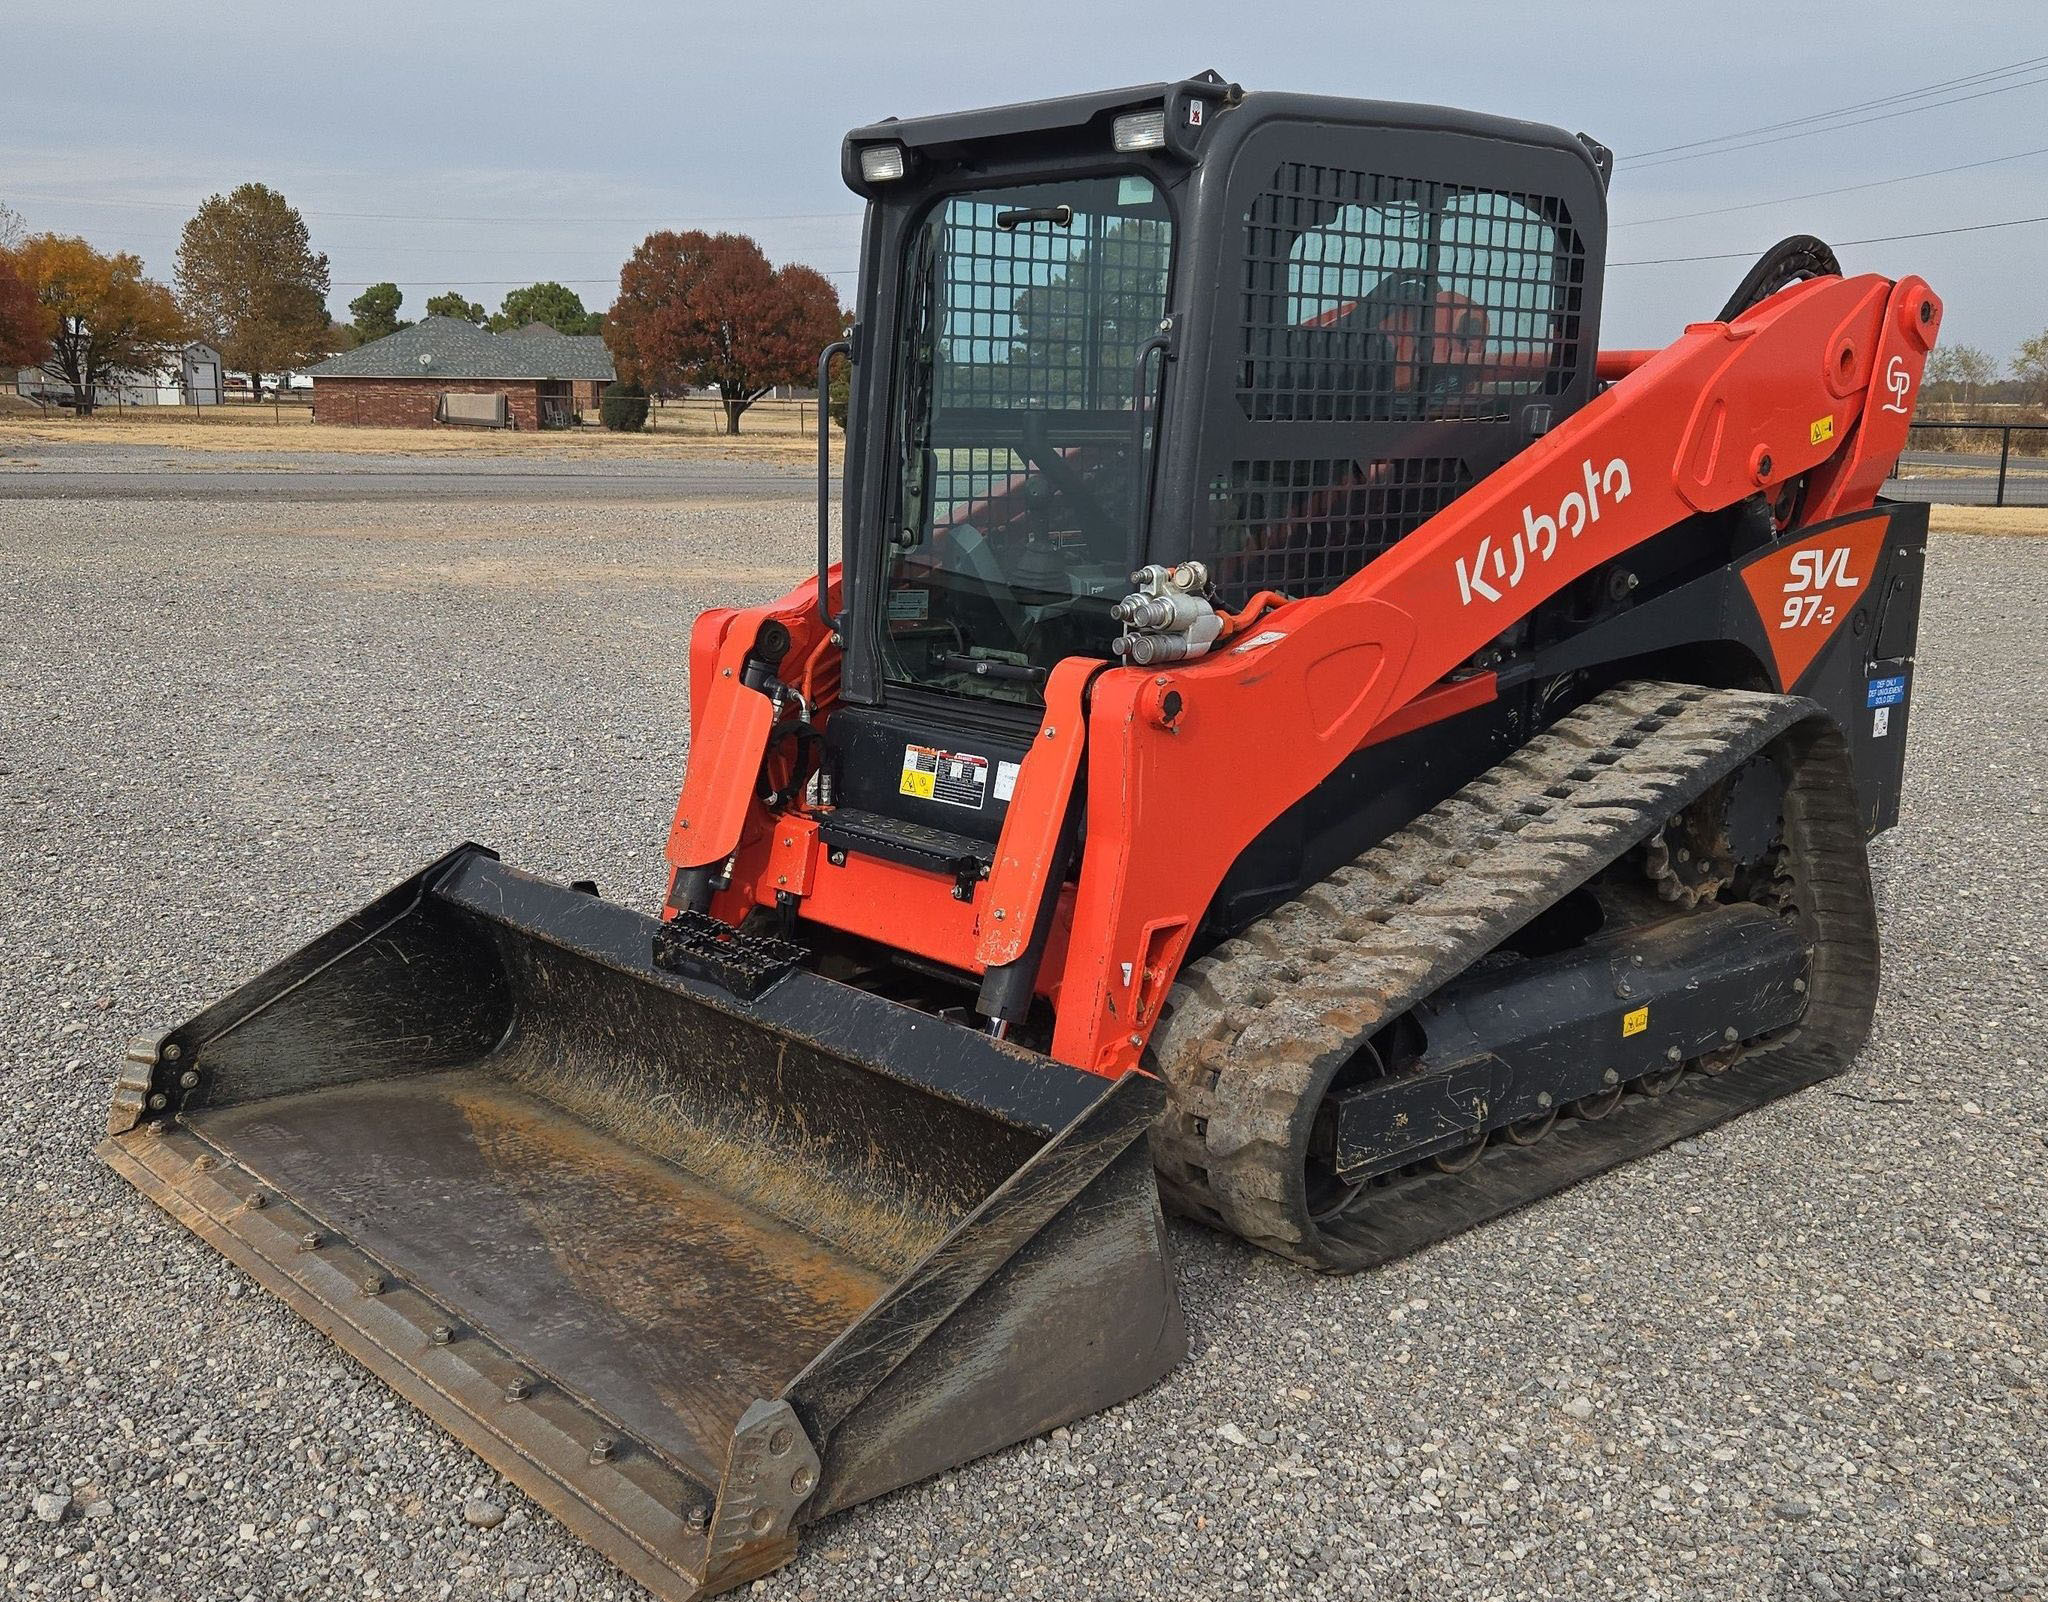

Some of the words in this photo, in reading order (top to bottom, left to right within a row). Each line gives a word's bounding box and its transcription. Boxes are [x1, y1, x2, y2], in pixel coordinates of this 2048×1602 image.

[1455, 458, 1632, 606] Kubota
[1783, 547, 1860, 593] SVL
[1877, 680, 1886, 688] DEF
[1886, 679, 1897, 687] ONLY
[1868, 689, 1877, 698] DEF
[1887, 694, 1895, 702] DEF
